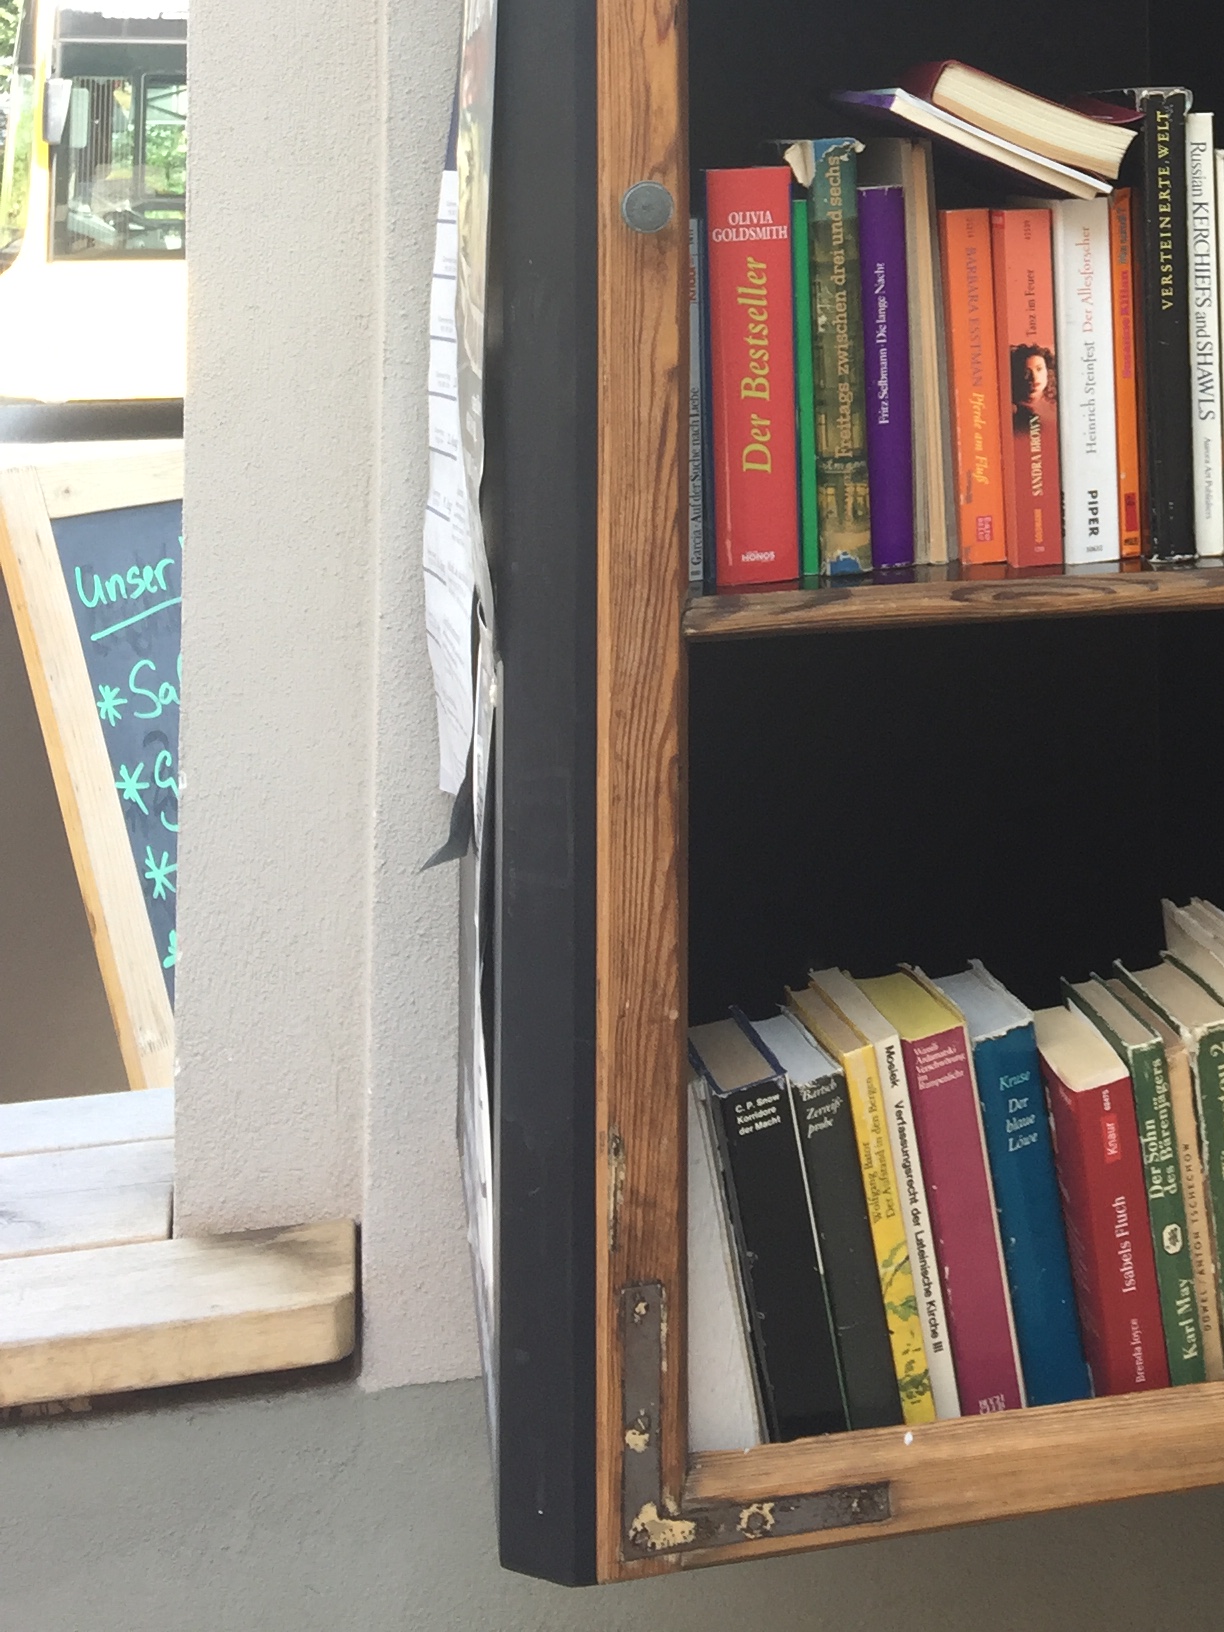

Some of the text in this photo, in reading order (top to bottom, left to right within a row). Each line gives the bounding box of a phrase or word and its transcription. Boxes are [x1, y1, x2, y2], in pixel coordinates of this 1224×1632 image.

[1155, 110, 1171, 159] WELT
[712, 225, 789, 243] GOLDSMITH
[728, 210, 774, 226] OLIVIA
[825, 155, 851, 383] zwischen drei und sechs
[1189, 141, 1216, 422] Russian KERCHIEFS and SHAWLS
[1022, 270, 1038, 337] Tanz im Feuer
[877, 324, 887, 344] Die
[736, 256, 773, 475] Der Bestseller
[1080, 308, 1098, 454] Heinrich Steinfest Der
[1029, 416, 1044, 497] SANDRA BROWN
[1204, 465, 1213, 479] Art
[1086, 489, 1101, 537] PIPER
[1205, 480, 1215, 520] Publishers
[736, 1106, 778, 1125] Korridore
[747, 1093, 781, 1111] P. Snow
[1006, 1114, 1036, 1133] blaue
[1008, 1097, 1029, 1113] Der
[1150, 1057, 1179, 1195] des Bärenjägers
[1008, 1133, 1038, 1152] Löwe
[1103, 1121, 1120, 1156] Knaur
[1140, 1118, 1166, 1201] Der Sohn
[884, 1044, 941, 1339] Mosiek Verfassungsrecht der Lateinische Kirche
[1181, 1142, 1206, 1277] ANTON TSCHECHOW
[1111, 1195, 1147, 1384] Brenda Isabels Fluch
[1174, 1278, 1199, 1361] Karl May
